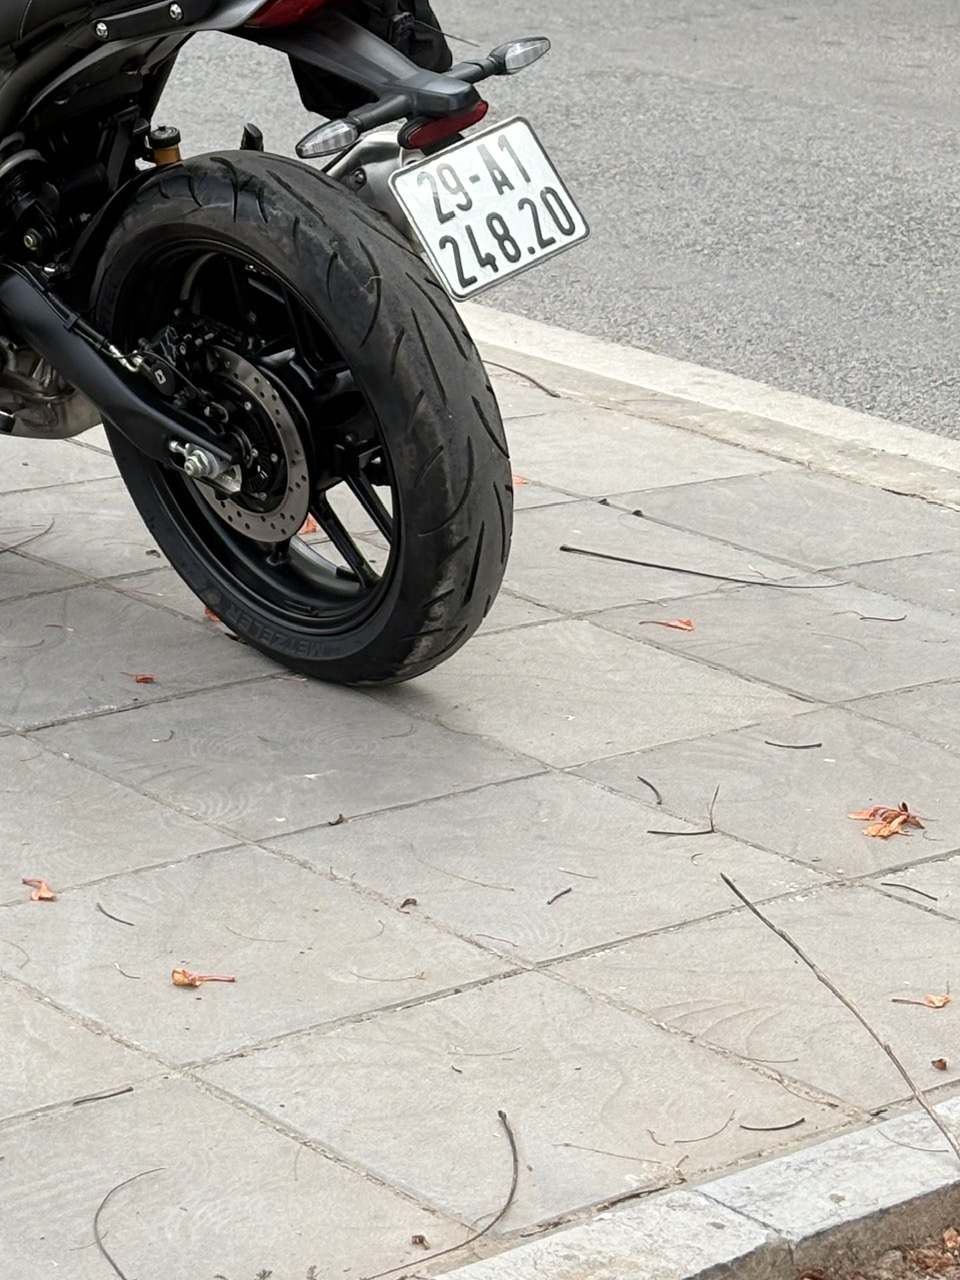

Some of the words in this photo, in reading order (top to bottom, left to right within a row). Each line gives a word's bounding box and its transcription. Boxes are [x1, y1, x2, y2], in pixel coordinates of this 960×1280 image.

[416, 134, 532, 224] 29-A1
[439, 186, 576, 288] 248.20
[225, 603, 326, 659] METZELER
